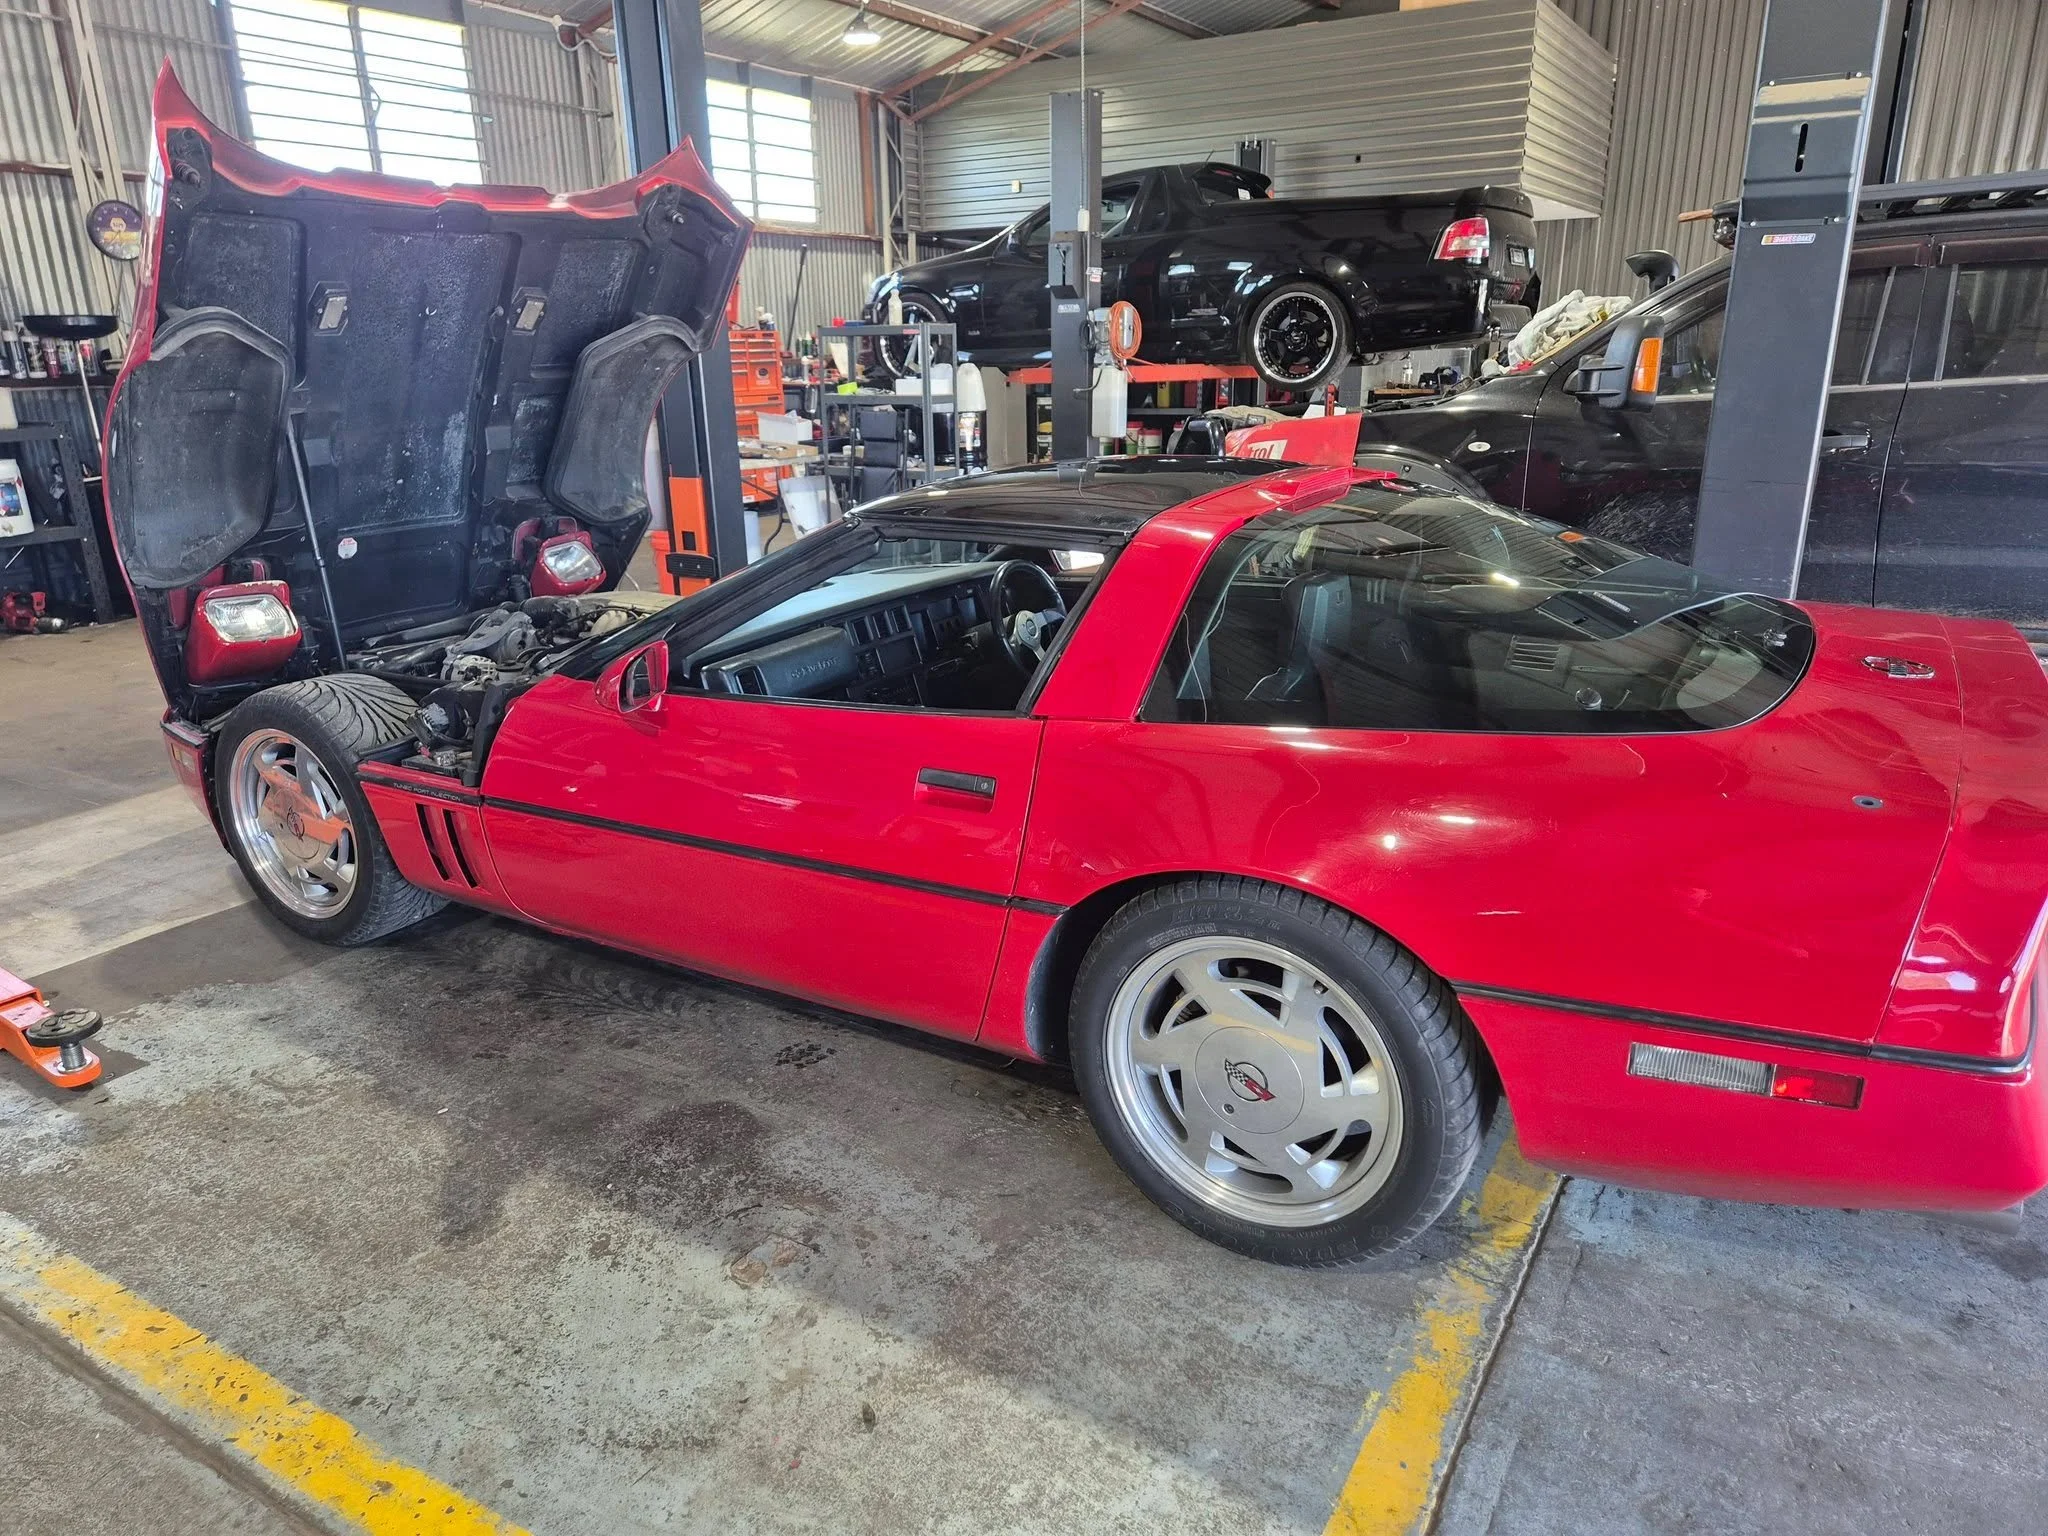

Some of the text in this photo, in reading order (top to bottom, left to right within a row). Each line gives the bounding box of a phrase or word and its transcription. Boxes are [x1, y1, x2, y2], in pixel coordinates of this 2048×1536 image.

[393, 782, 461, 802] TUNED PORT INJECTION
